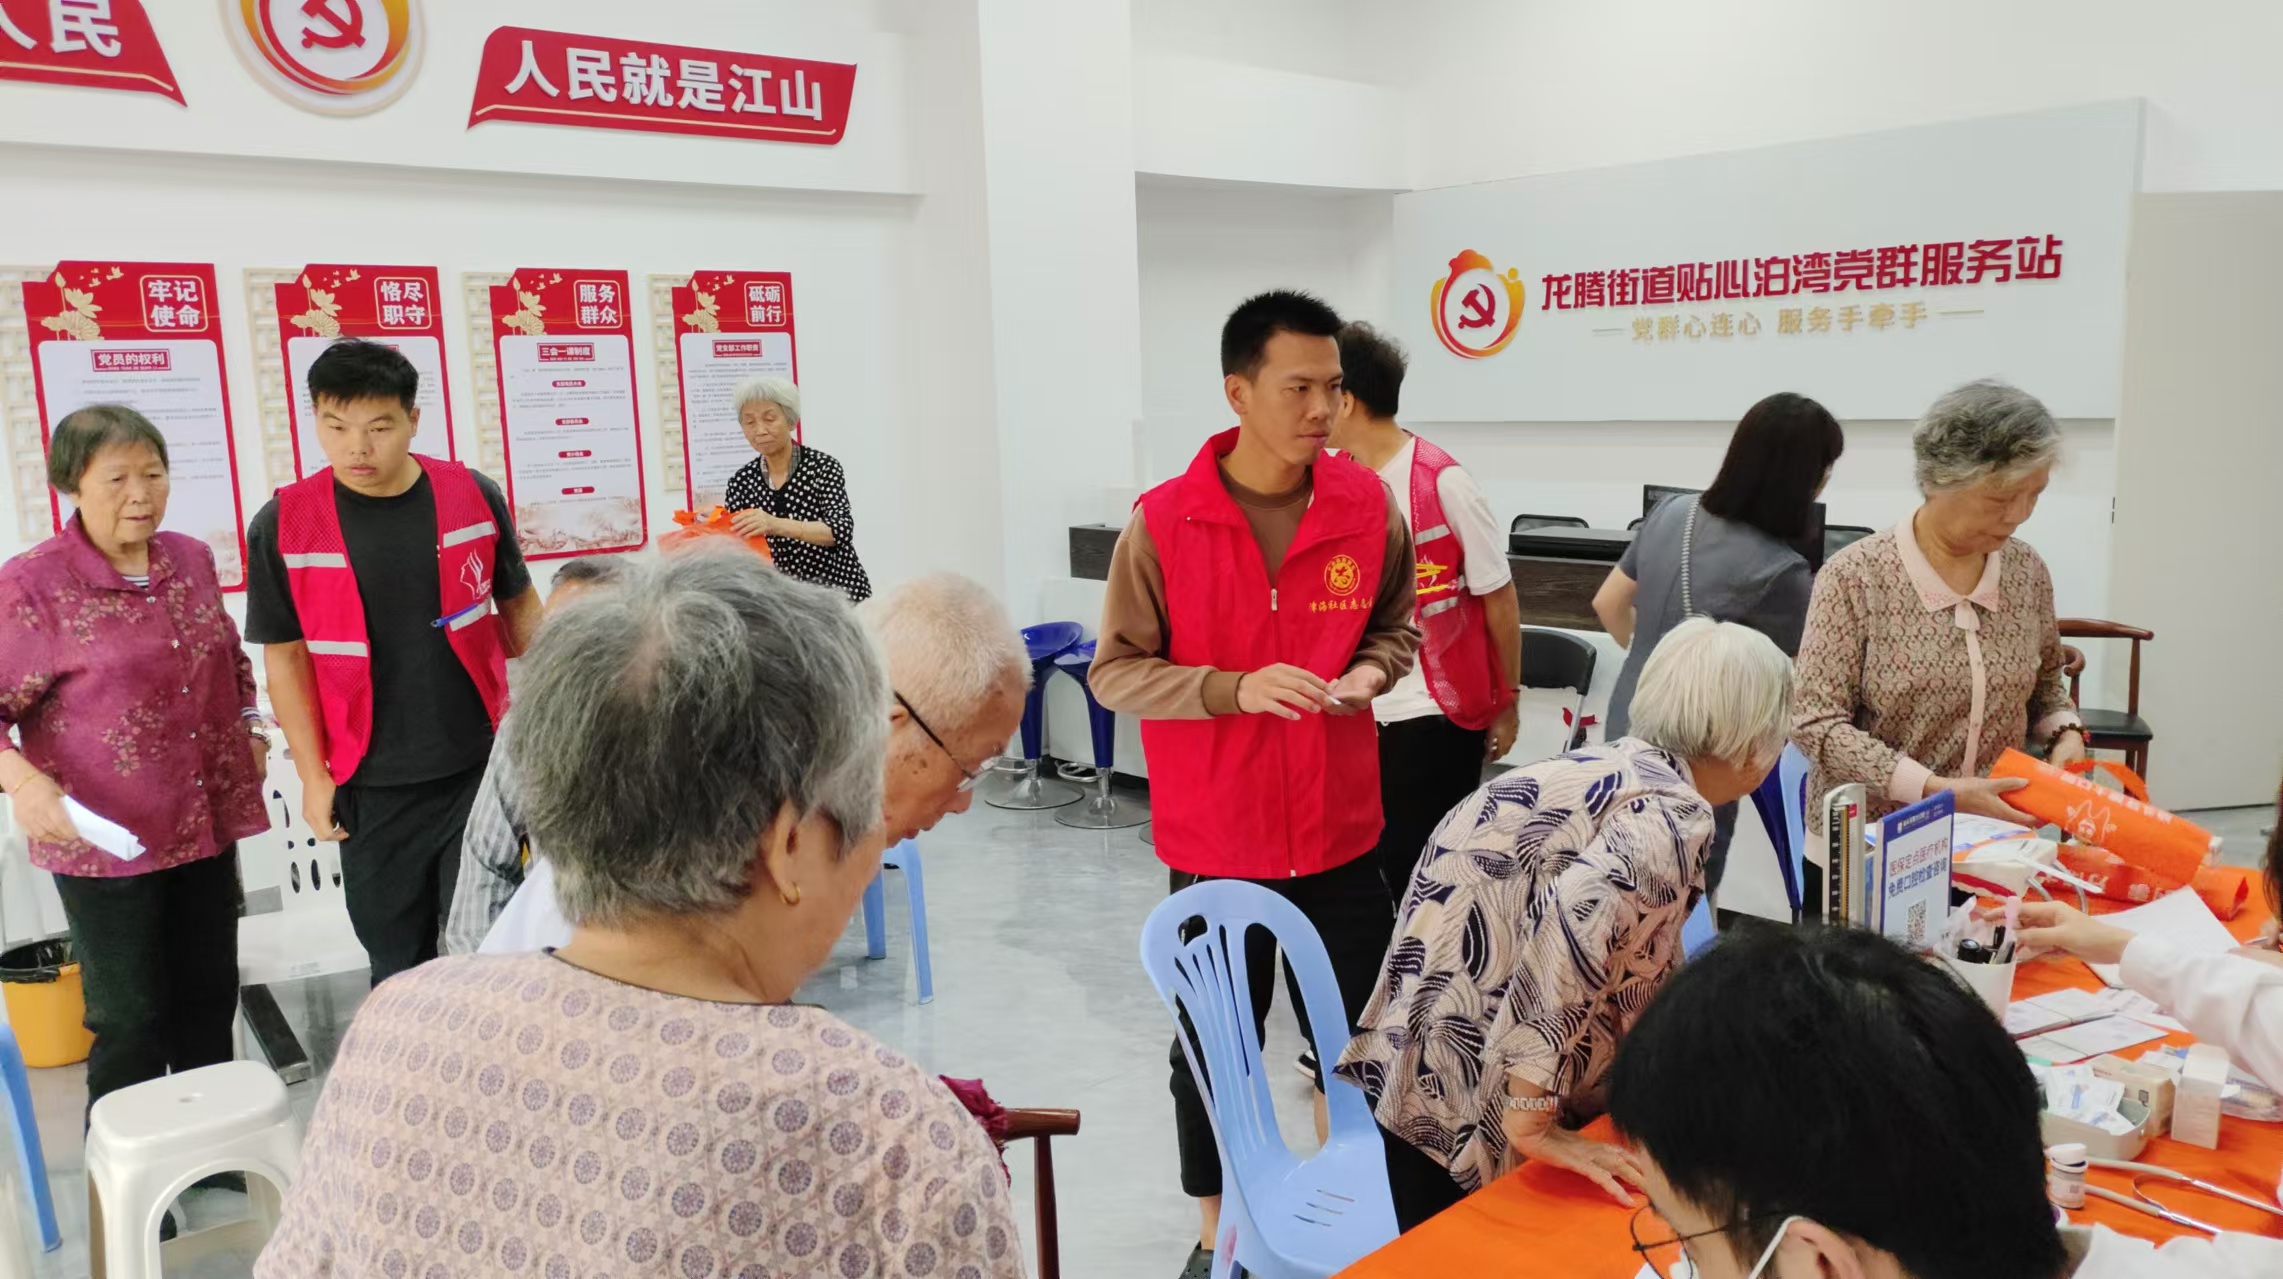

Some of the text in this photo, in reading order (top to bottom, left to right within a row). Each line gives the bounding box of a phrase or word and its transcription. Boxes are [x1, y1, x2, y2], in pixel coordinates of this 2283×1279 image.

[504, 39, 823, 121] 人民就是江山
[1541, 233, 2063, 311] 龙腾街道贴心泊湾党群服务站
[148, 280, 199, 302] 牢记
[381, 281, 424, 302] 恪尽
[580, 284, 615, 303] 服务
[749, 285, 780, 302] 砥砺
[150, 304, 201, 328] 使命
[382, 304, 426, 325] 职守
[581, 305, 618, 324] 群众
[750, 305, 782, 322] 前行
[1632, 302, 1927, 341] 党群心连心 服务手牵手
[98, 353, 165, 366] 党员的权利
[1889, 838, 1948, 877] 医保定点医疗机构
[1888, 857, 1947, 899] 免费口腔检查咨询
